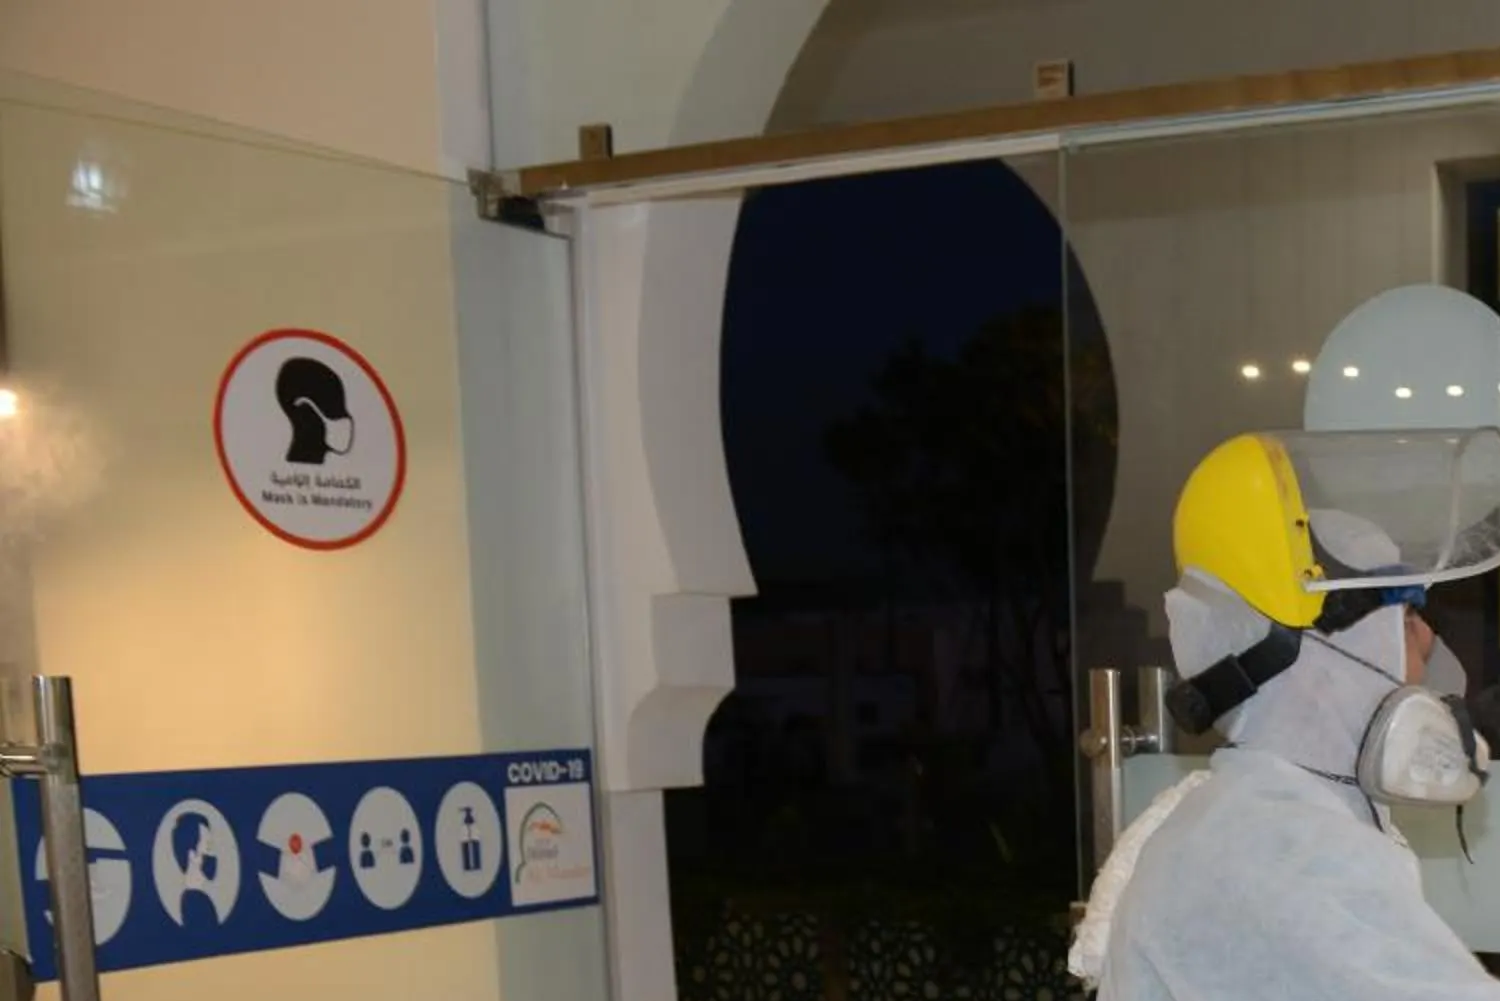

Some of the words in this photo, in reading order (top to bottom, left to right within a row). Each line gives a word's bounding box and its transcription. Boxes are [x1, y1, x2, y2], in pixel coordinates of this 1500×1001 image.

[261, 489, 294, 505] Mask
[310, 493, 373, 510] Mandatory
[507, 759, 585, 784] COVID-19
